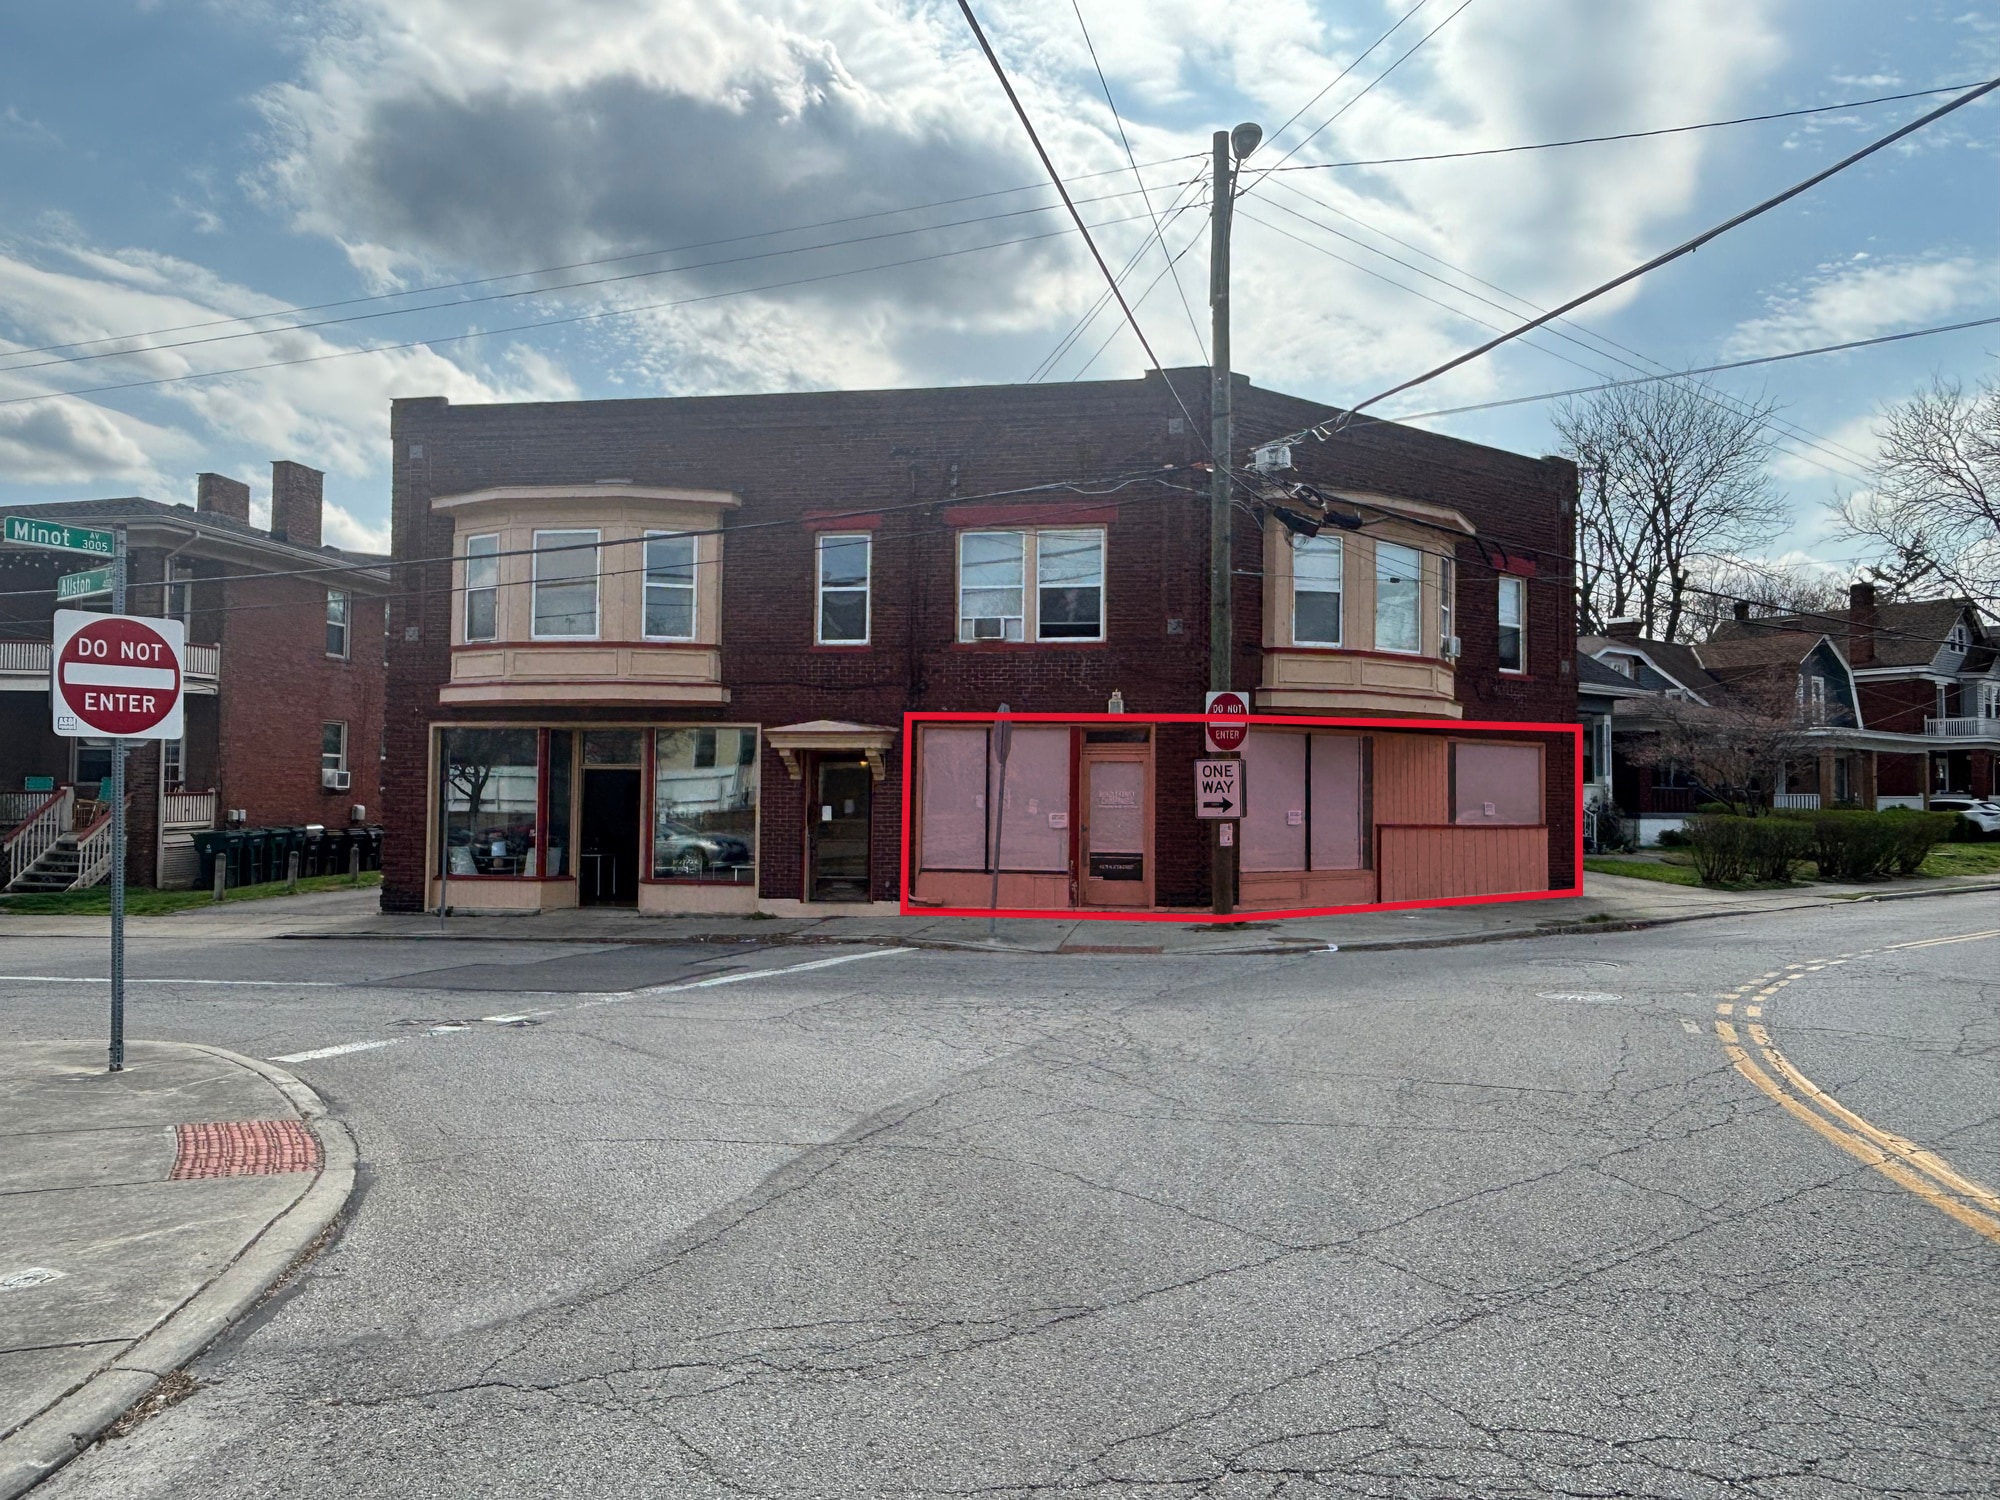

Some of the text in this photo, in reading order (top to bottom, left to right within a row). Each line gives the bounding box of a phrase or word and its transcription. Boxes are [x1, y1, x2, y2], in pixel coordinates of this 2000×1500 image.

[14, 520, 70, 546] Minot
[89, 532, 100, 540] AV
[82, 539, 108, 552] 3005
[60, 576, 91, 596] Allston
[78, 638, 163, 661] DO NOT
[84, 692, 156, 713] ENTER
[1212, 704, 1242, 714] DO NOT
[1215, 730, 1240, 740] ENTER
[1202, 765, 1234, 778] ONE
[1202, 780, 1234, 793] WAY
